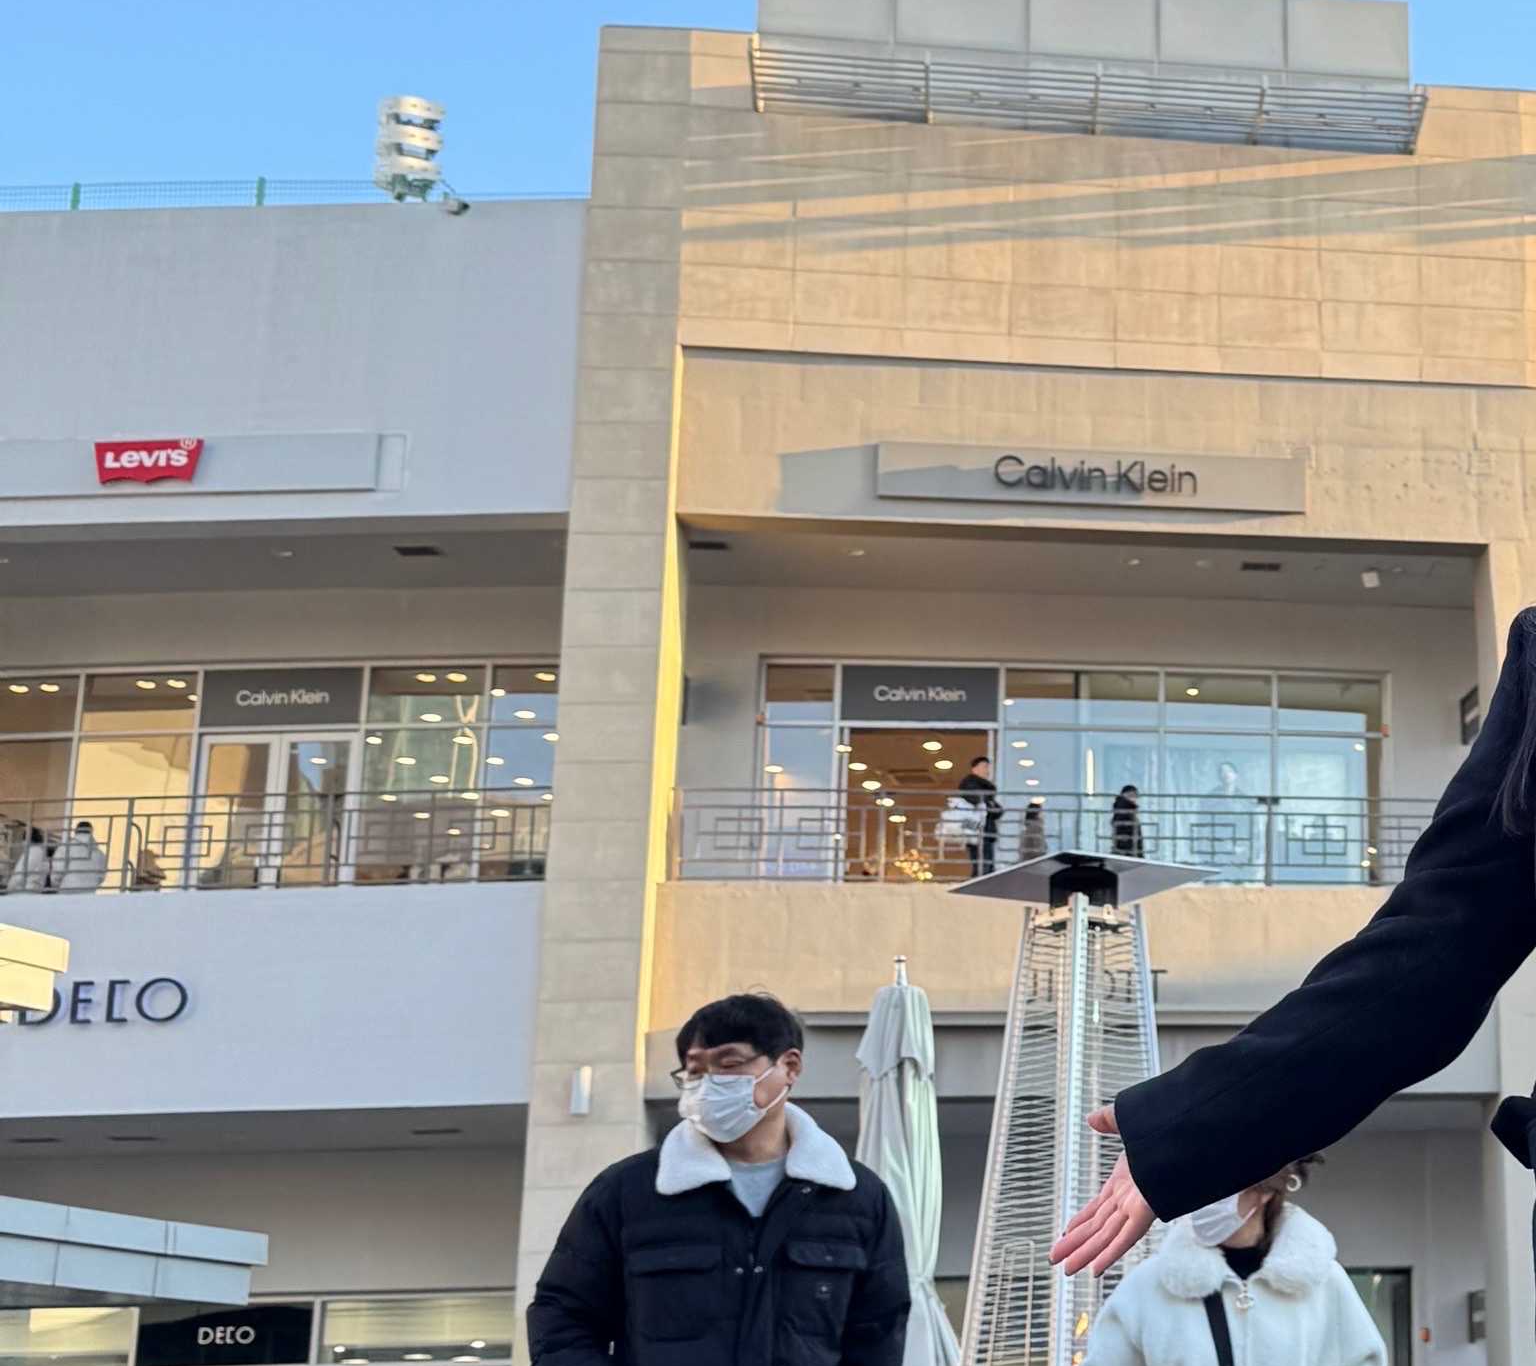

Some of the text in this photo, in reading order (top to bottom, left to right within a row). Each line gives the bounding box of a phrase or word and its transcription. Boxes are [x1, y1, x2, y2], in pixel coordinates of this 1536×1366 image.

[994, 455, 1198, 496] Calvin Klein
[236, 688, 330, 706] Calvin Klein
[873, 684, 967, 702] Calvin Klein
[197, 1325, 256, 1345] DECO
